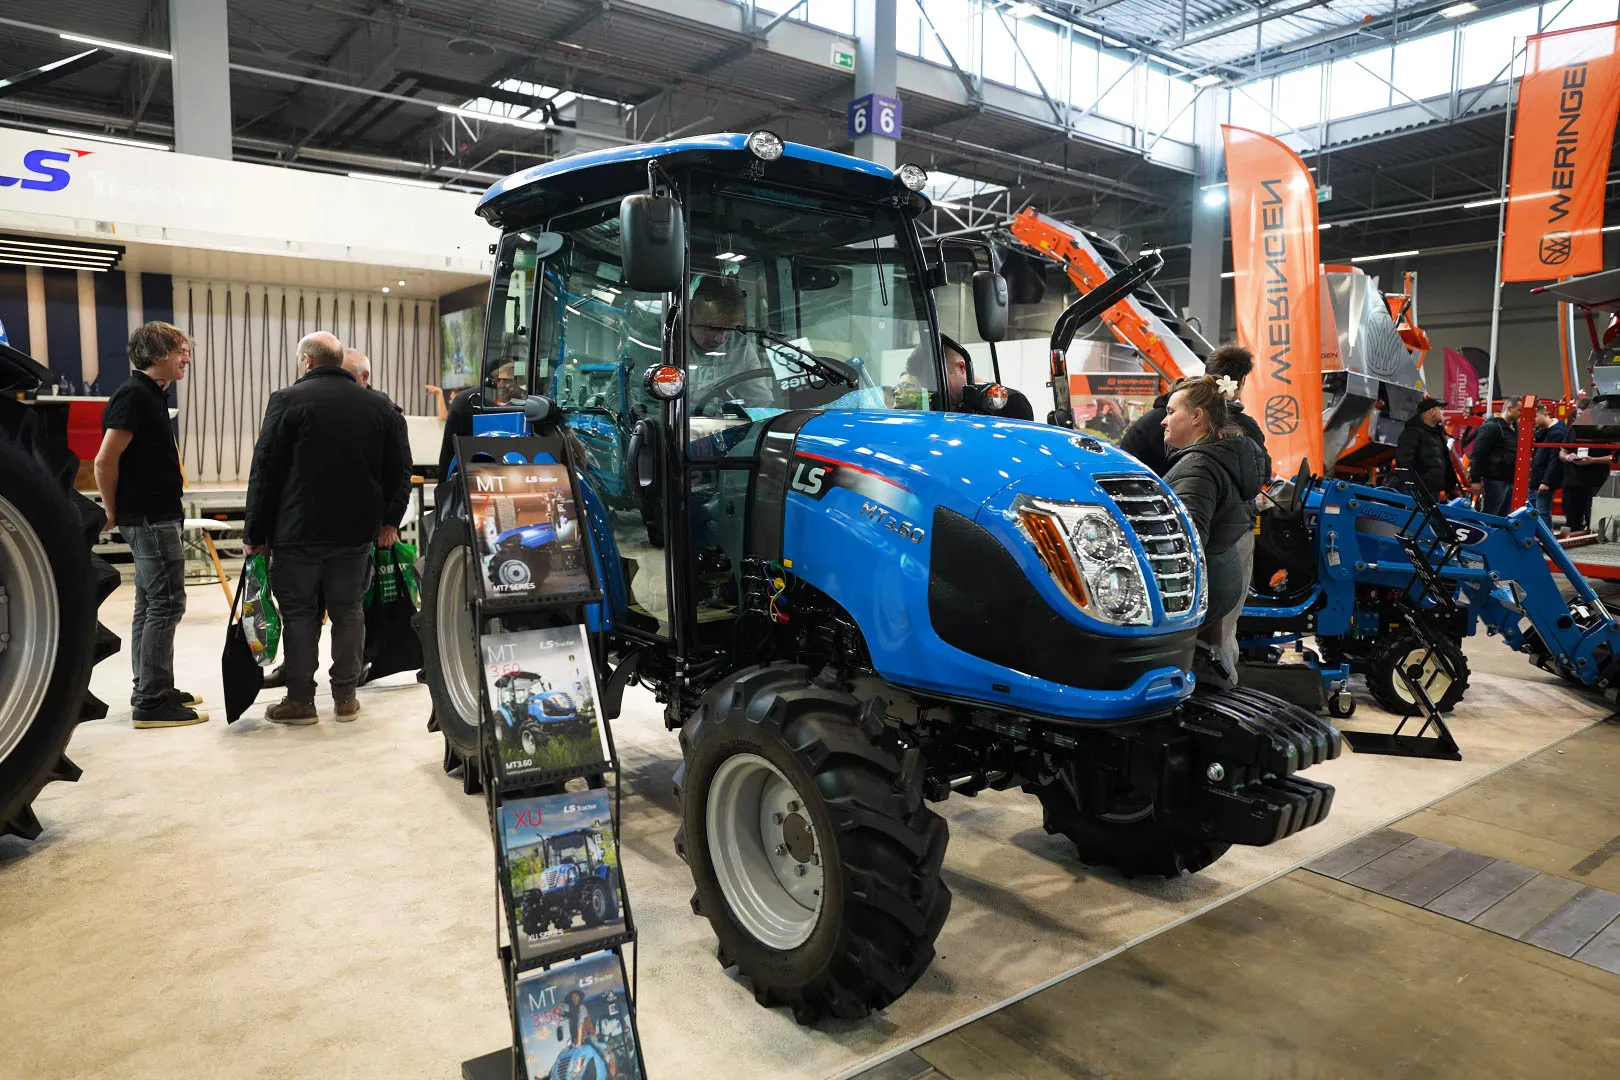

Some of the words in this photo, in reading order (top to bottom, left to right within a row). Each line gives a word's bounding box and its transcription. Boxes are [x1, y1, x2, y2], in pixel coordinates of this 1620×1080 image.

[854, 109, 866, 133] 6
[880, 108, 895, 133] 6
[476, 475, 506, 492] MT
[525, 475, 538, 483] LS
[792, 463, 826, 495] LS
[479, 494, 490, 511] 7
[859, 501, 925, 544] MT3.60
[1455, 528, 1471, 542] S
[493, 583, 509, 592] MT7
[509, 582, 536, 591] SERIES
[540, 640, 554, 649] LS
[487, 643, 518, 663] MT
[490, 663, 521, 678] 3.60
[505, 759, 533, 770] MT3.60
[564, 804, 576, 813] LS
[514, 808, 543, 829] XU
[528, 933, 538, 942] XU
[579, 975, 594, 987] LS
[528, 985, 558, 1012] MT
